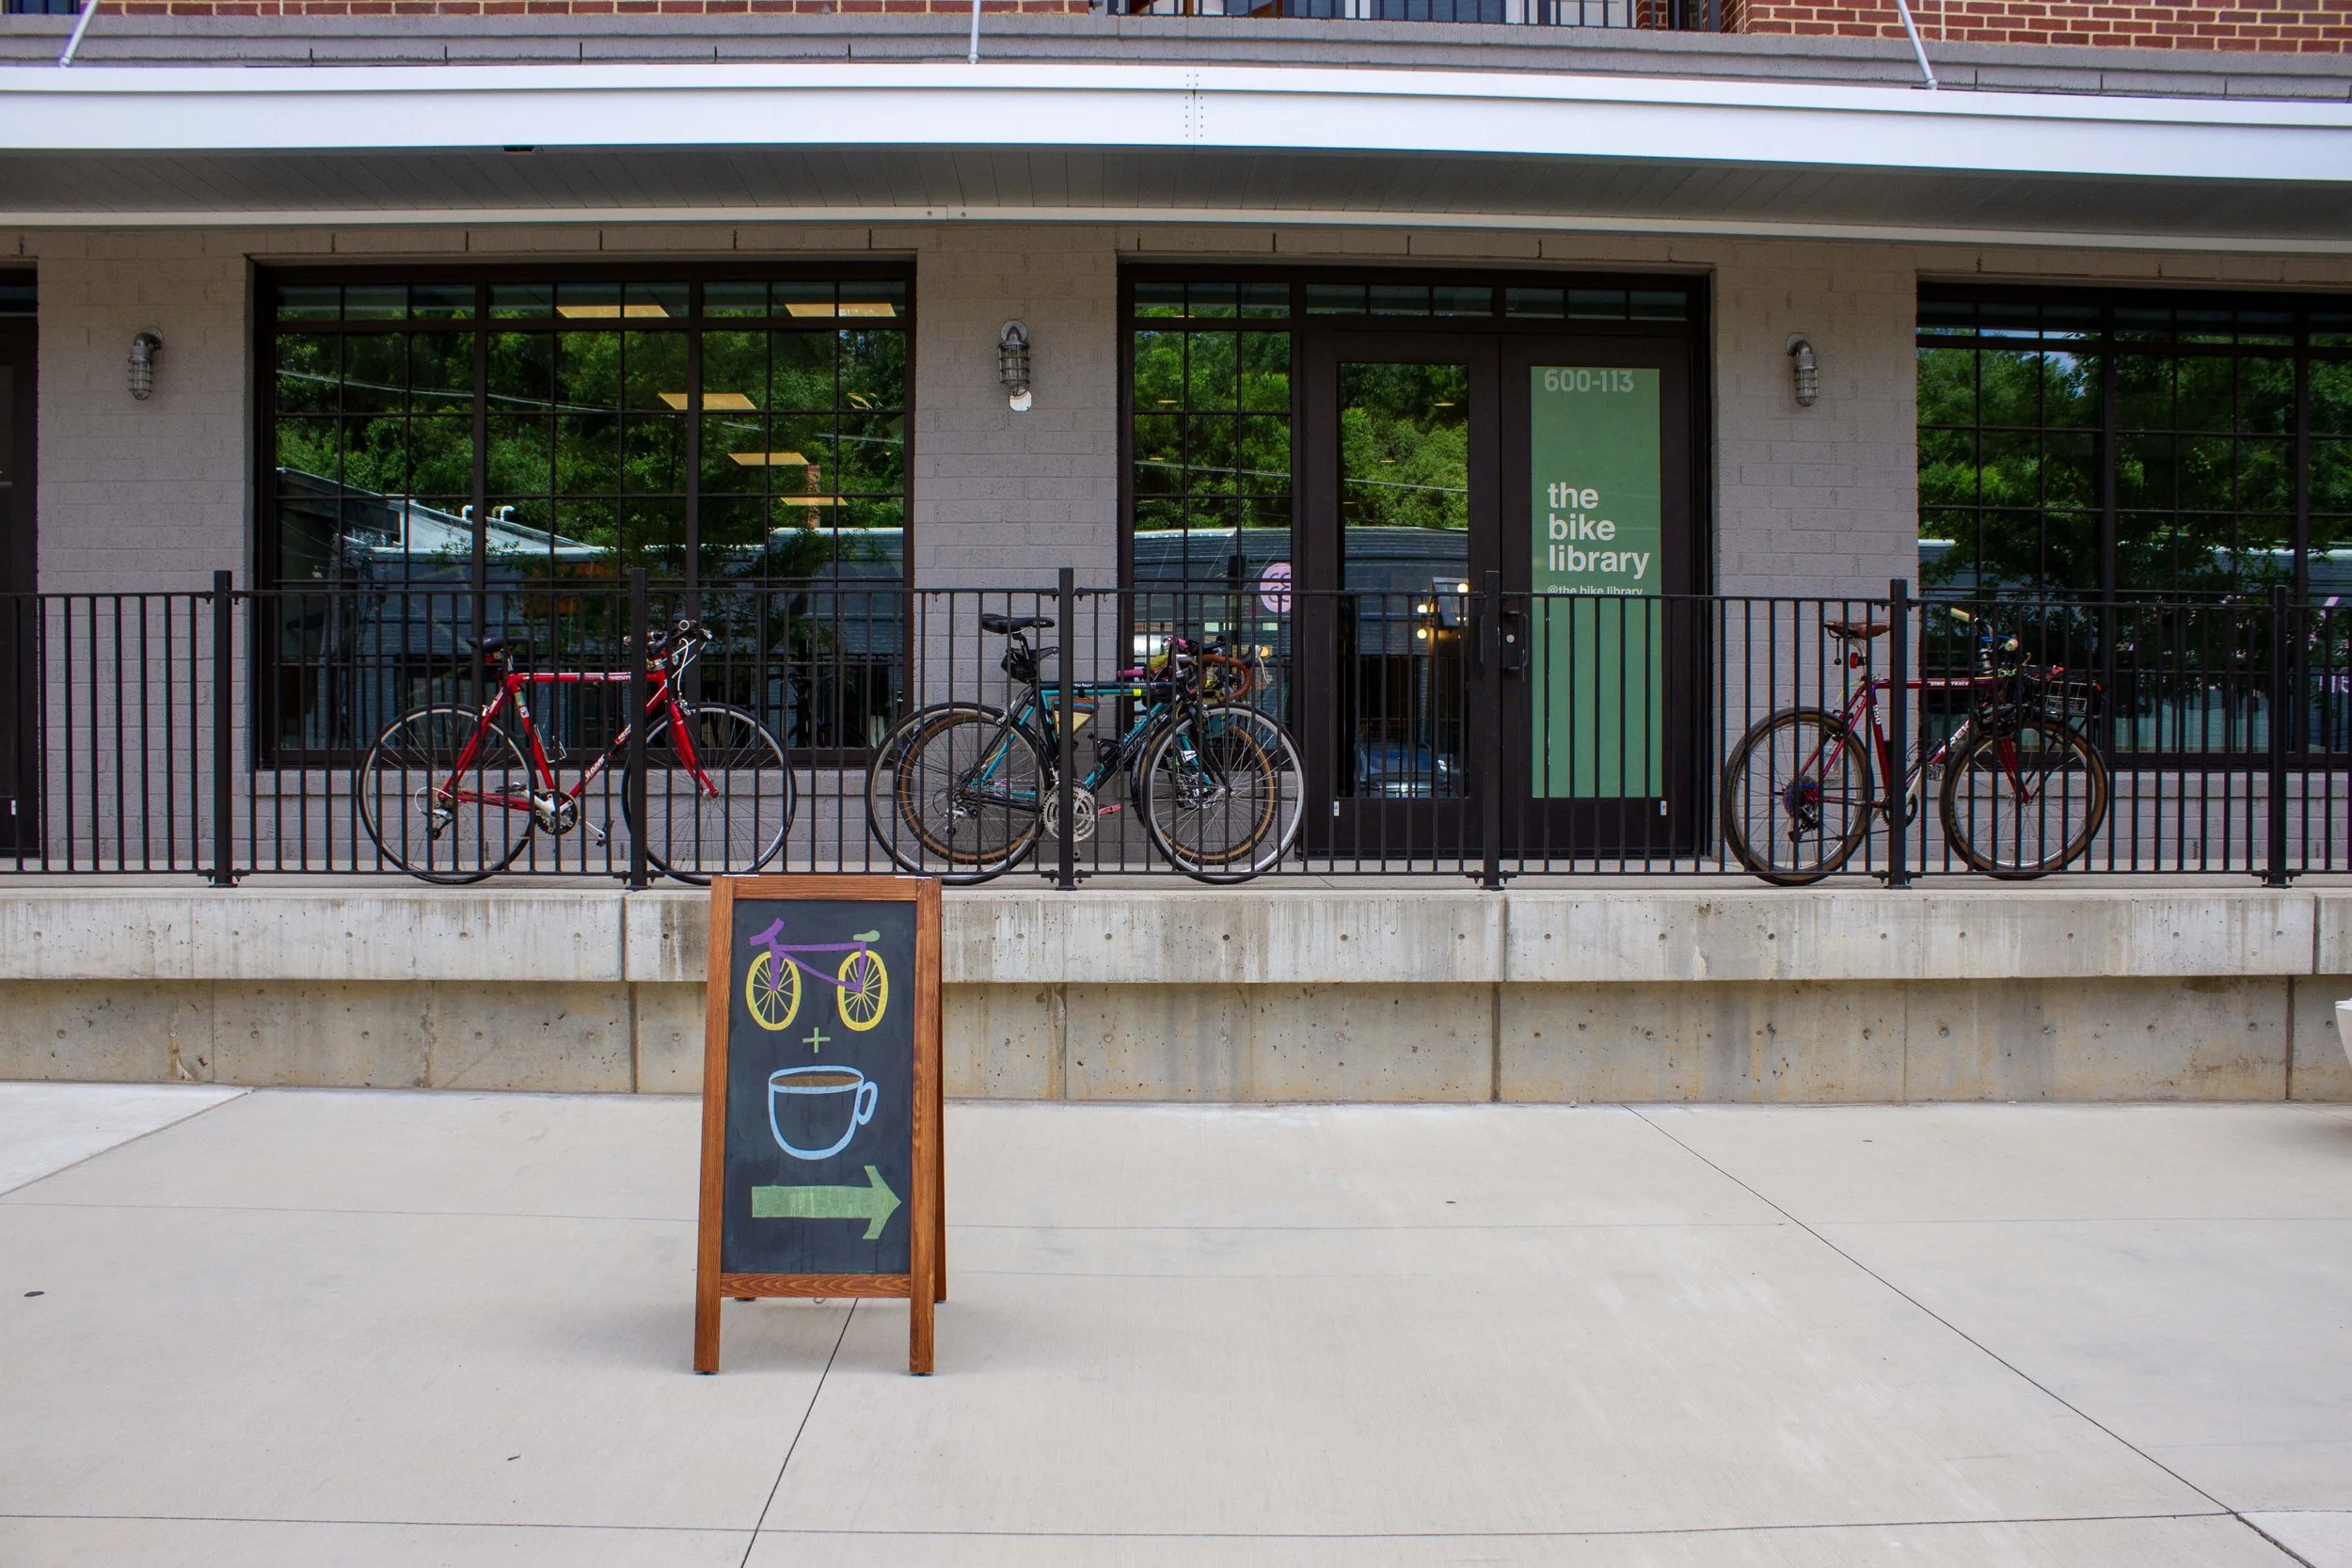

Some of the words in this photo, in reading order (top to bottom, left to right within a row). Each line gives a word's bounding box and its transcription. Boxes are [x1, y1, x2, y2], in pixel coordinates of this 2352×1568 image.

[1544, 369, 1634, 392] 600-113
[1548, 482, 1598, 509] the
[1549, 513, 1615, 541] bike
[1549, 545, 1650, 579] library
